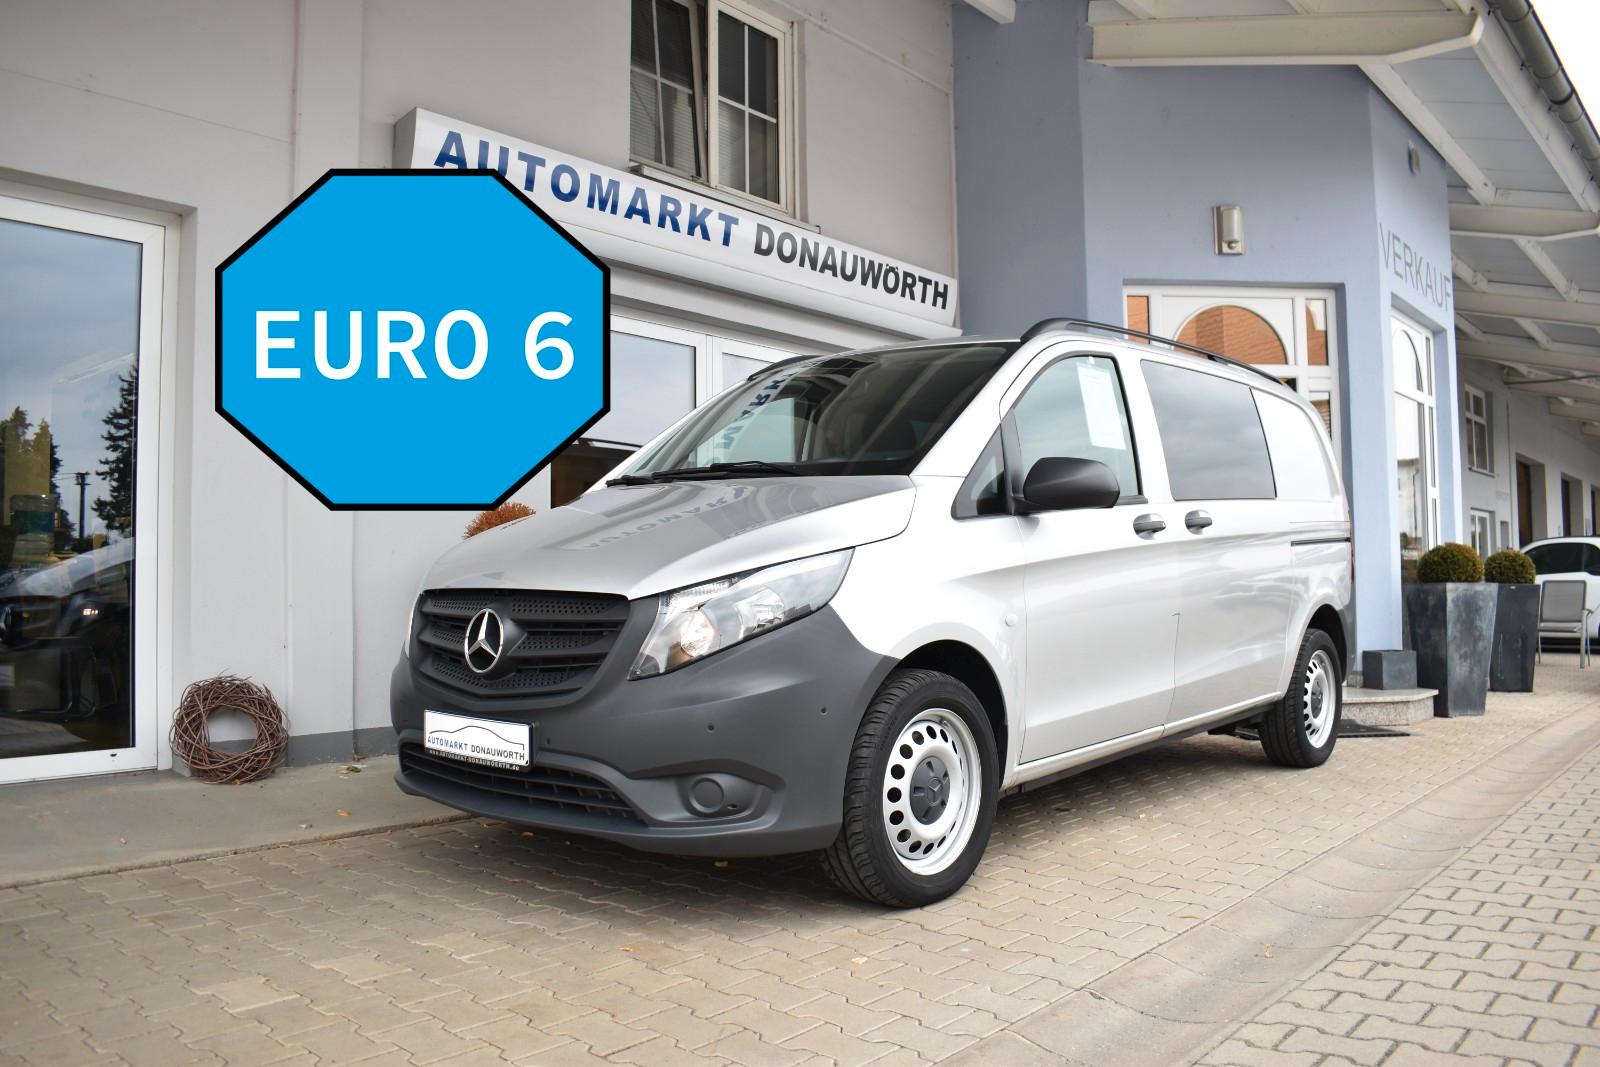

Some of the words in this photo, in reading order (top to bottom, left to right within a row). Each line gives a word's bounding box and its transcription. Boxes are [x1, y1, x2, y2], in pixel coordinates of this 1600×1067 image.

[434, 131, 739, 247] AUTOMARKT
[754, 222, 949, 310] DONAUWÖRTH
[1379, 222, 1451, 312] VERKAUF
[427, 735, 468, 751] AUTOMARKT
